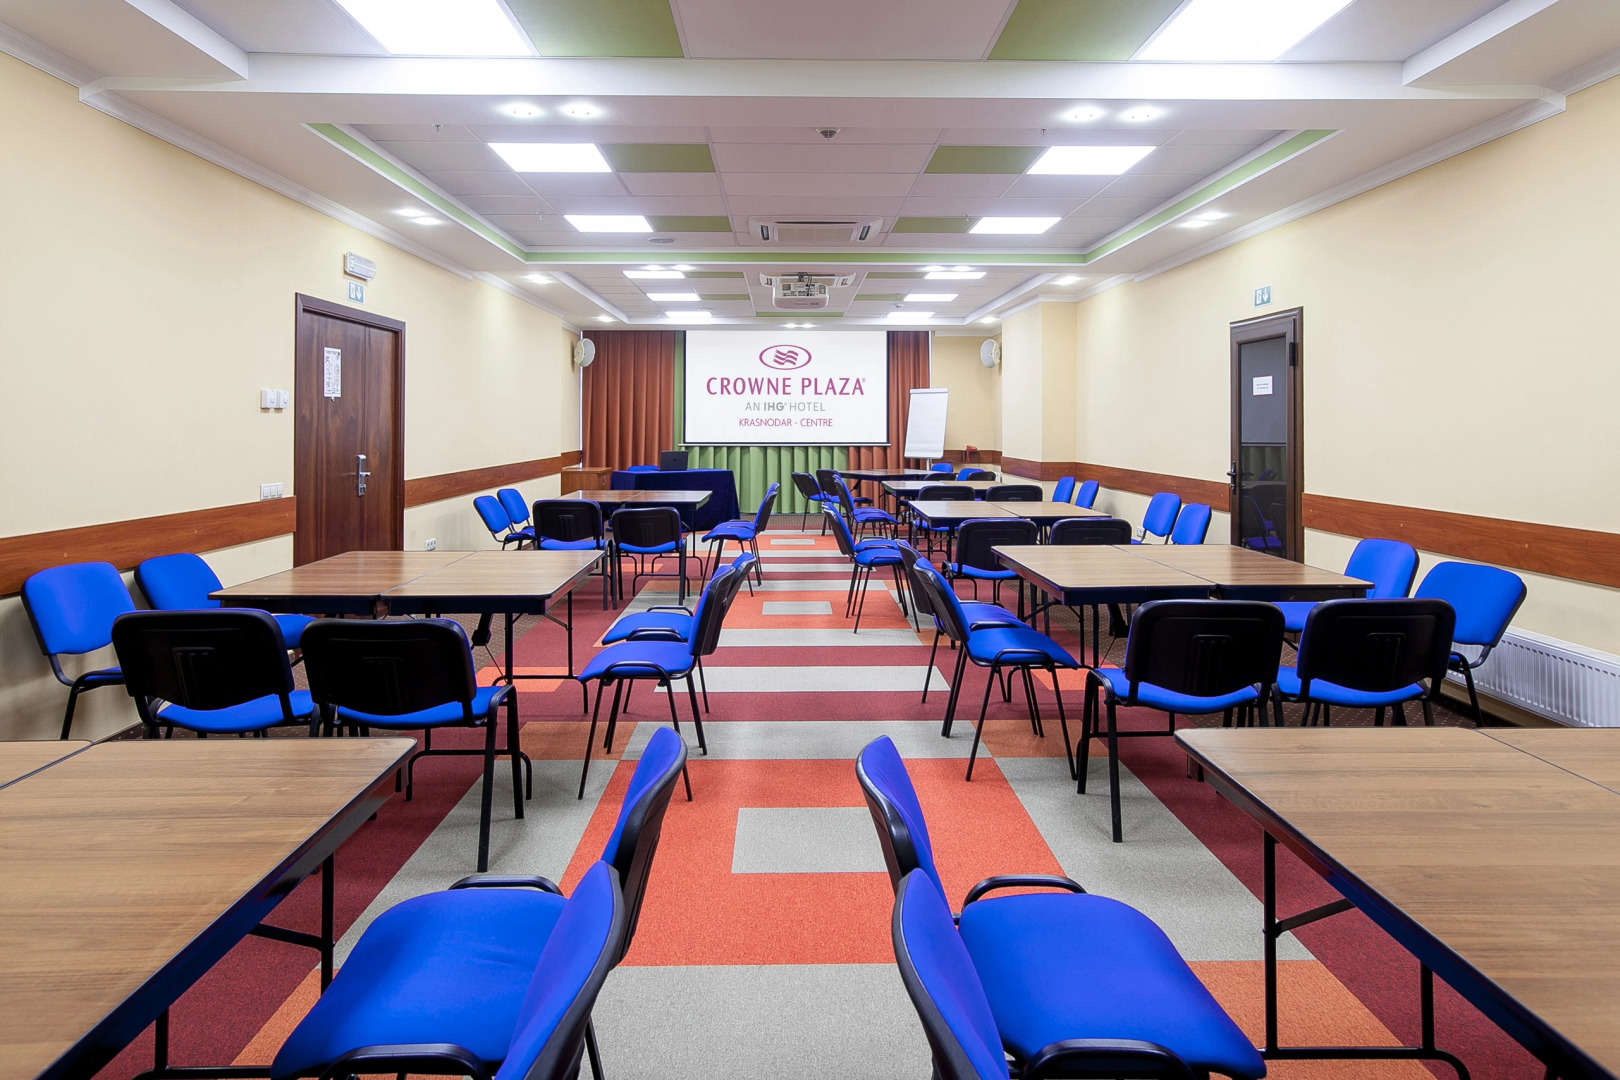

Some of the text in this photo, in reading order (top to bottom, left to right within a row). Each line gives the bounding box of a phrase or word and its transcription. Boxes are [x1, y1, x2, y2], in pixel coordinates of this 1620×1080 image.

[706, 377, 792, 396] CROWNE
[745, 402, 761, 412] AN
[789, 402, 826, 412] HOTEL
[738, 418, 793, 427] KRASNODAR
[800, 418, 833, 427] CENTRE
